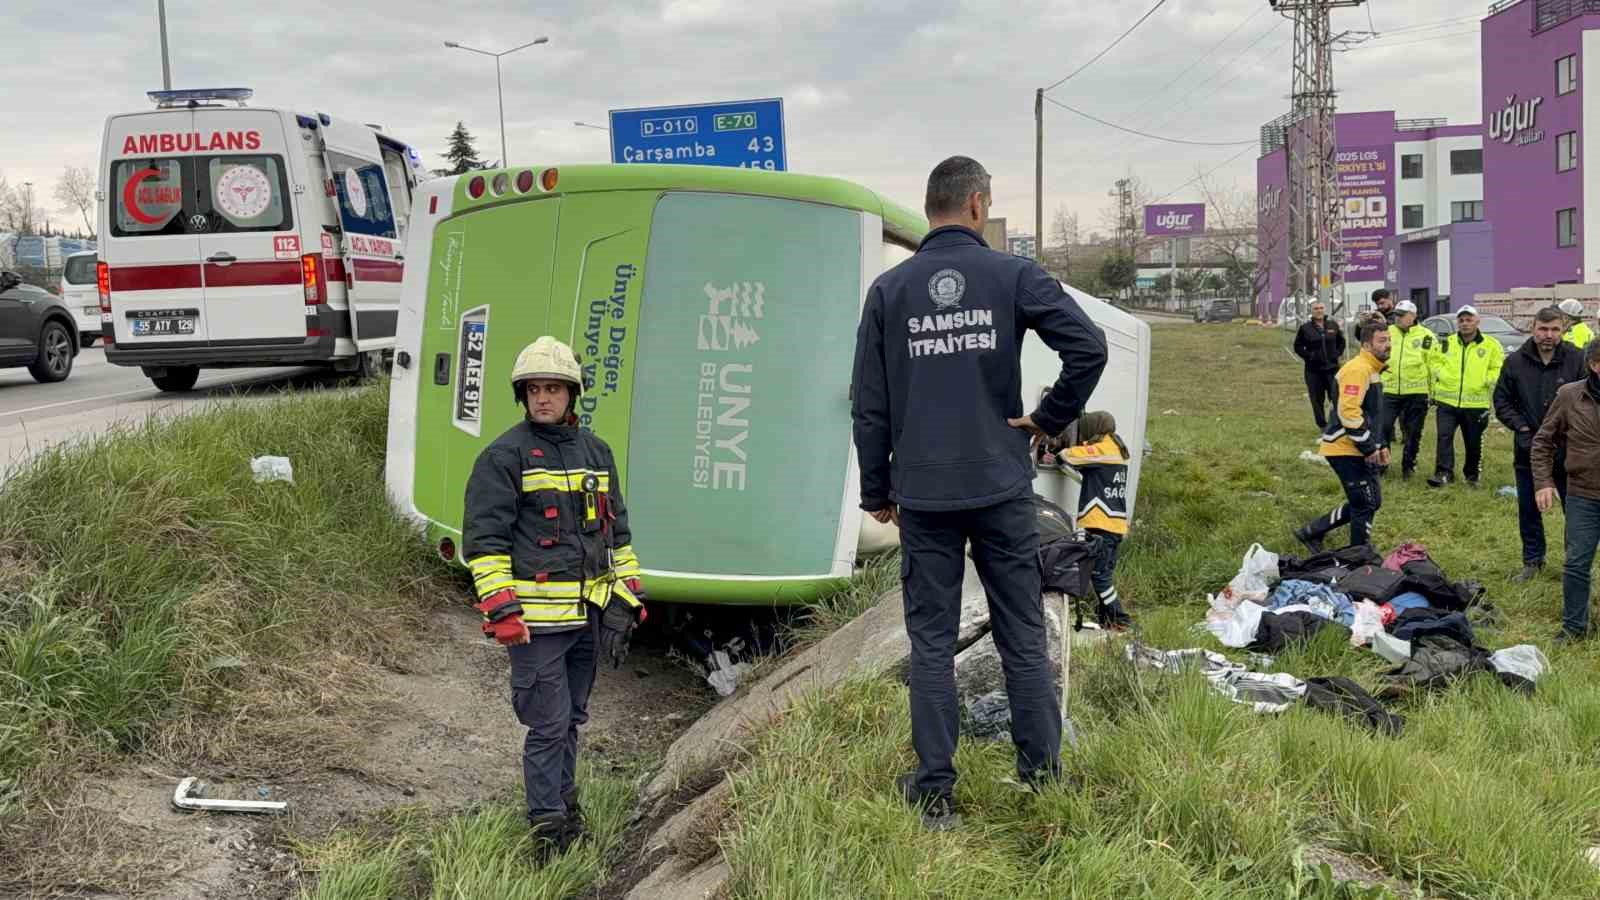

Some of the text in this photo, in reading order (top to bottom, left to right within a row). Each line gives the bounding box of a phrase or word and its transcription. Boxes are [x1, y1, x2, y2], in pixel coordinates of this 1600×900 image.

[643, 114, 754, 135] D-010 E-70
[1489, 94, 1542, 143] uğur
[122, 130, 261, 155] AMBULANS
[623, 136, 775, 164] Çarşamba 43
[1156, 211, 1194, 229] uğur
[276, 238, 298, 250] 112
[154, 319, 171, 331] ATY
[601, 263, 636, 397] Ünye Değer,
[908, 309, 993, 334] SAMSUN
[463, 331, 484, 419] 52 AEE 917
